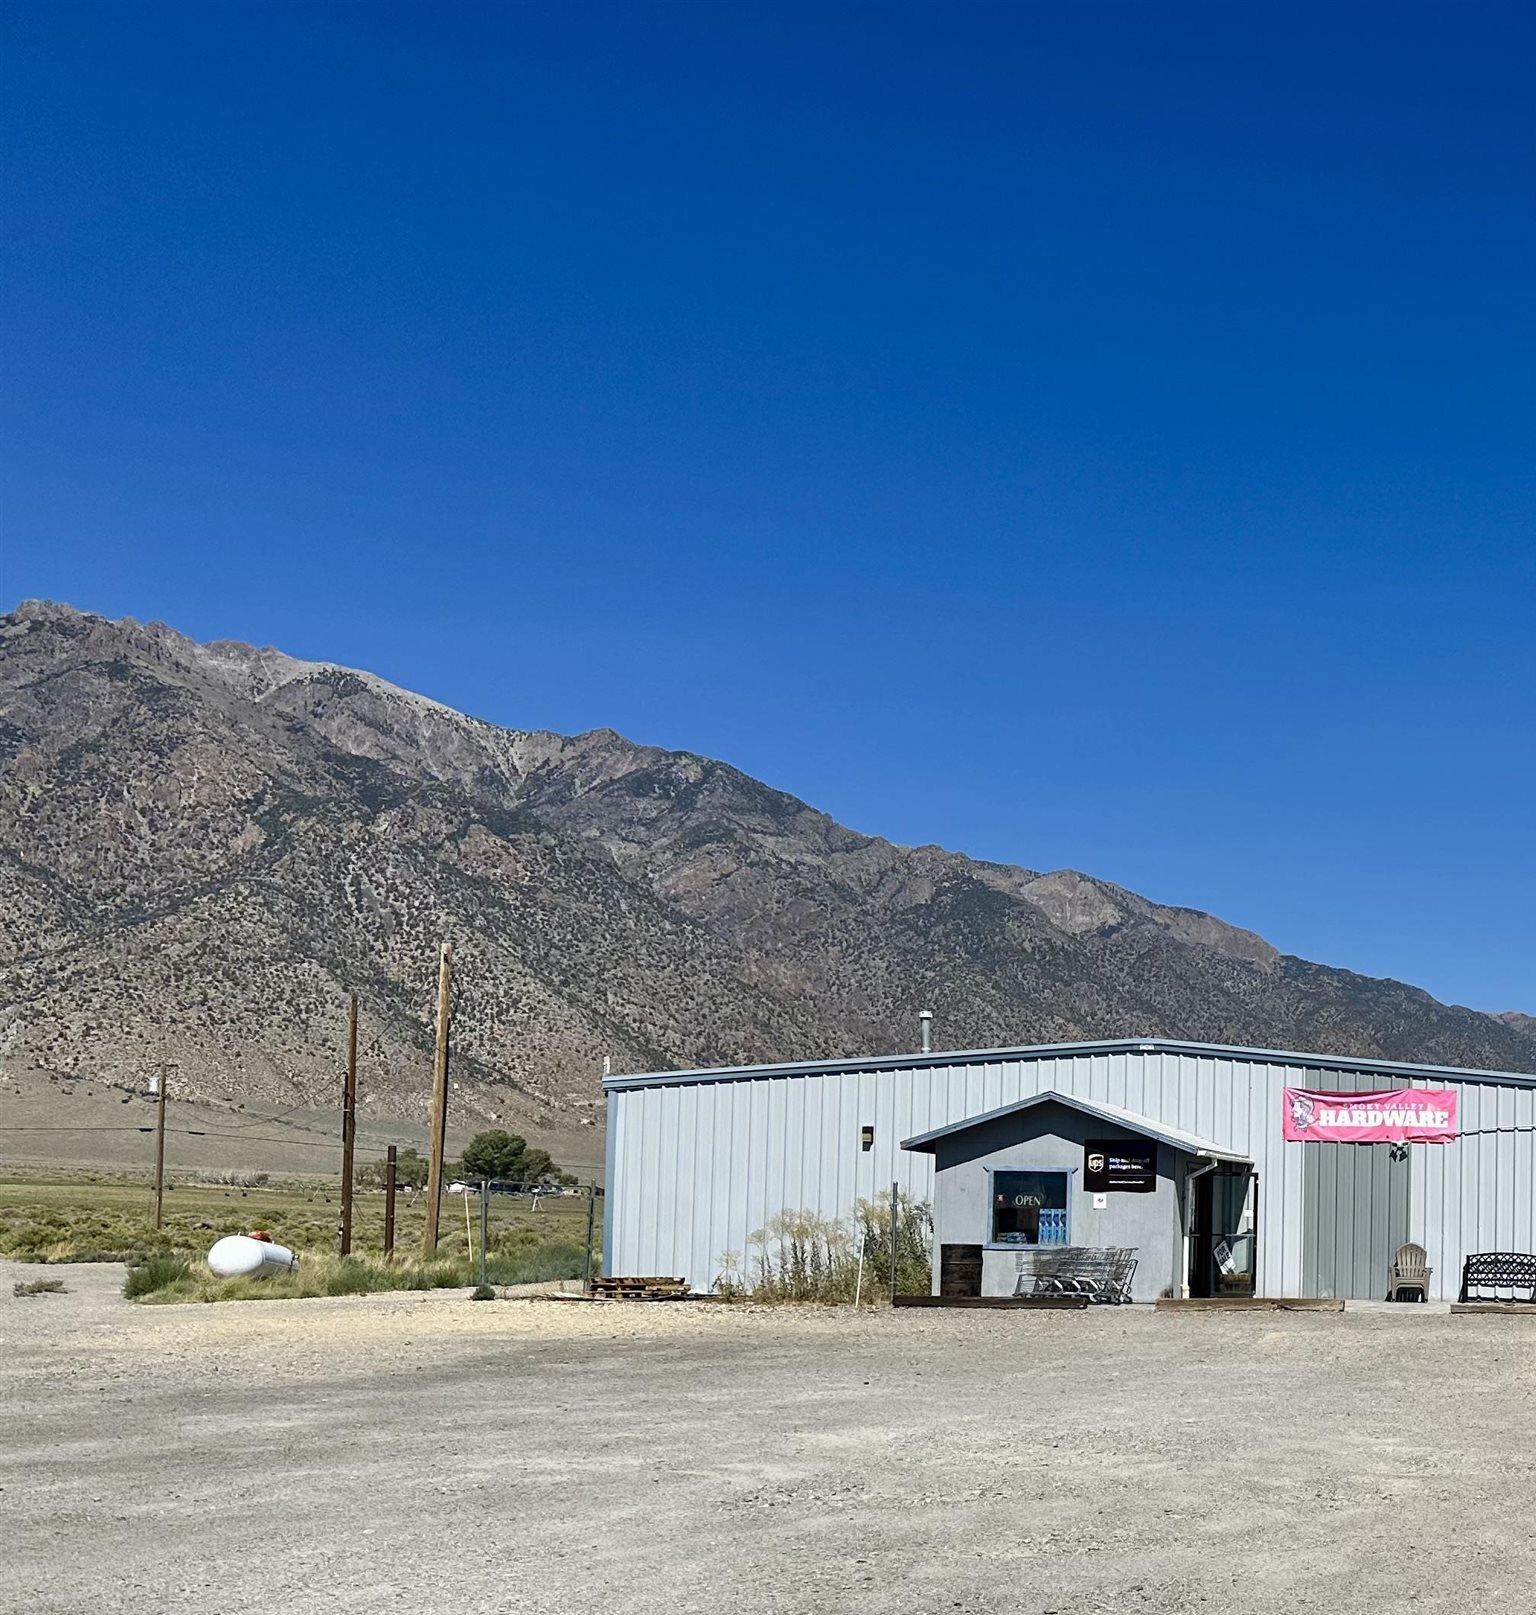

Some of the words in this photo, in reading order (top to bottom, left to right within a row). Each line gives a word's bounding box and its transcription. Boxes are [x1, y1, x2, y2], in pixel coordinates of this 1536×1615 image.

[1385, 1102, 1424, 1110] VALLEY
[1320, 1109, 1449, 1127] HARDWARE
[1015, 1195, 1040, 1206] OPEN
